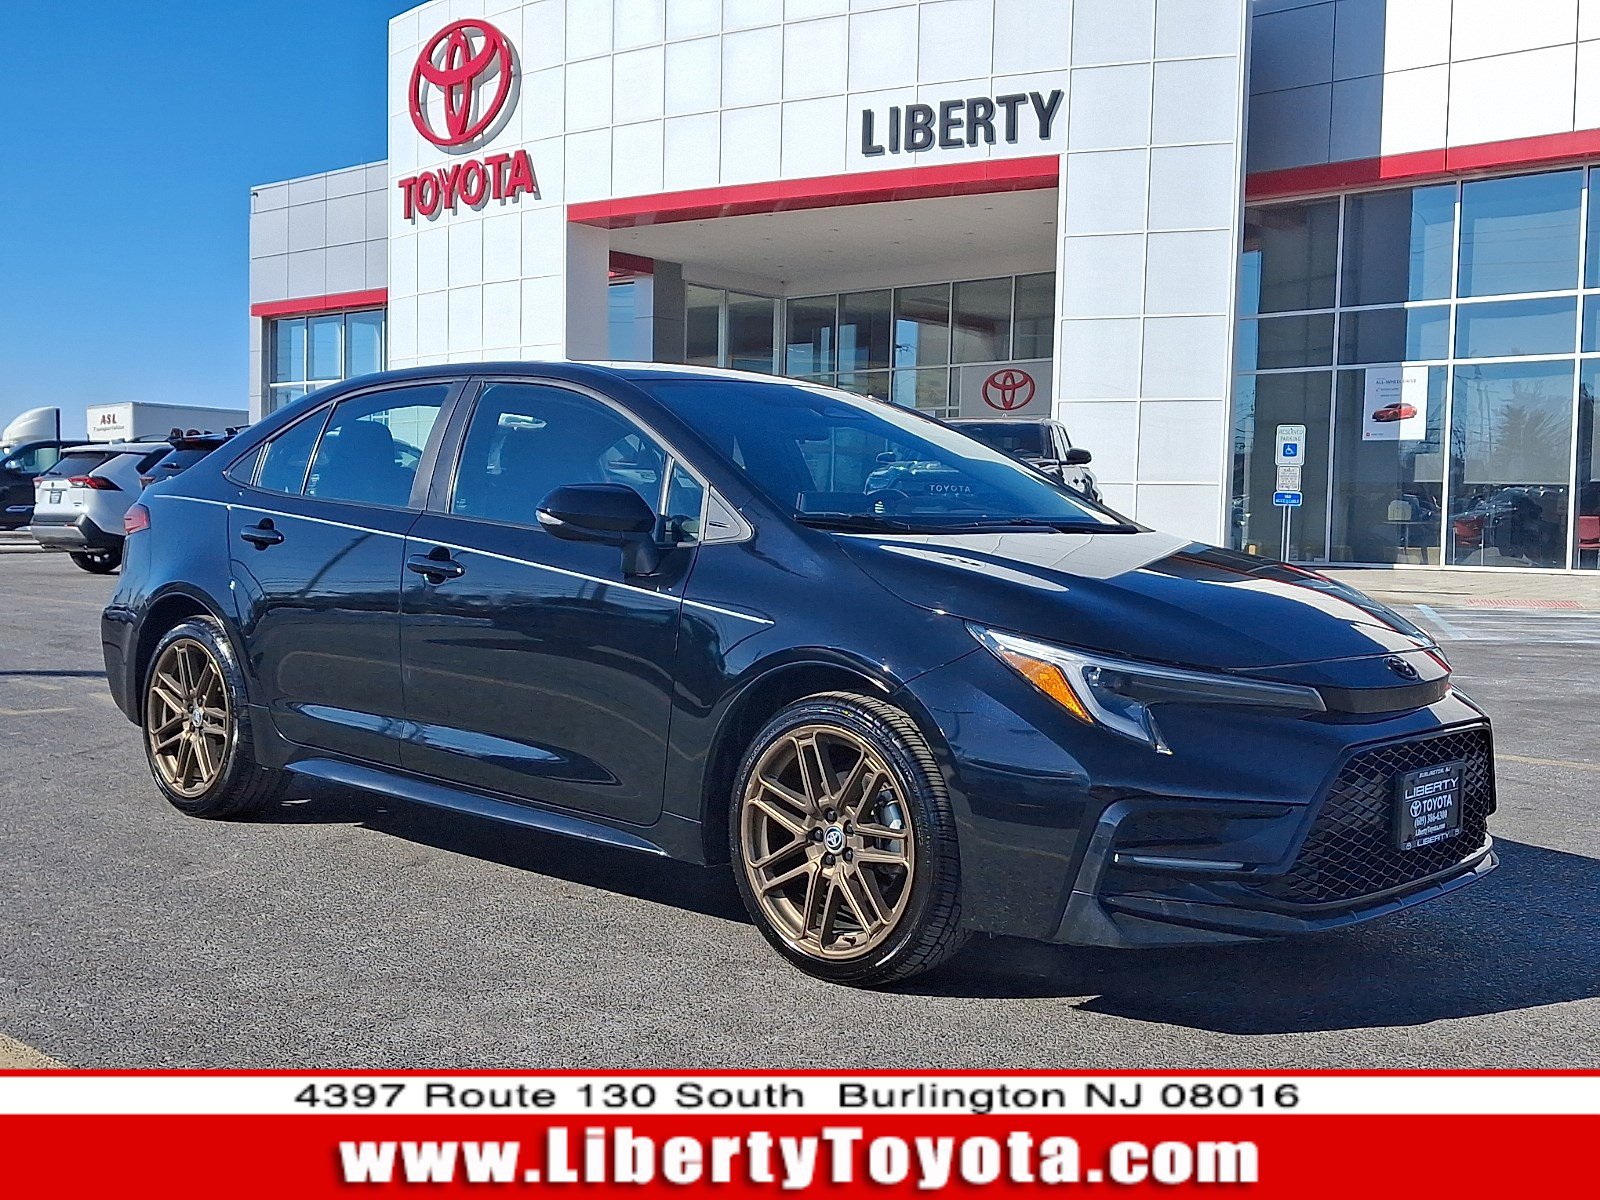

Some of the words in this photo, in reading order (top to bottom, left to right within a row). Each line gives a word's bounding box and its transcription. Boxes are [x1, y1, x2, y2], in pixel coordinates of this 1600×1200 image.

[861, 89, 1064, 157] LIBERTY
[398, 149, 540, 225] TOYOTA
[100, 413, 118, 425] ASL
[929, 484, 971, 493] TOYOTA
[1405, 776, 1459, 799] LIBERTY
[1422, 794, 1453, 812] TOYOTA
[1417, 832, 1449, 846] LIBERTY
